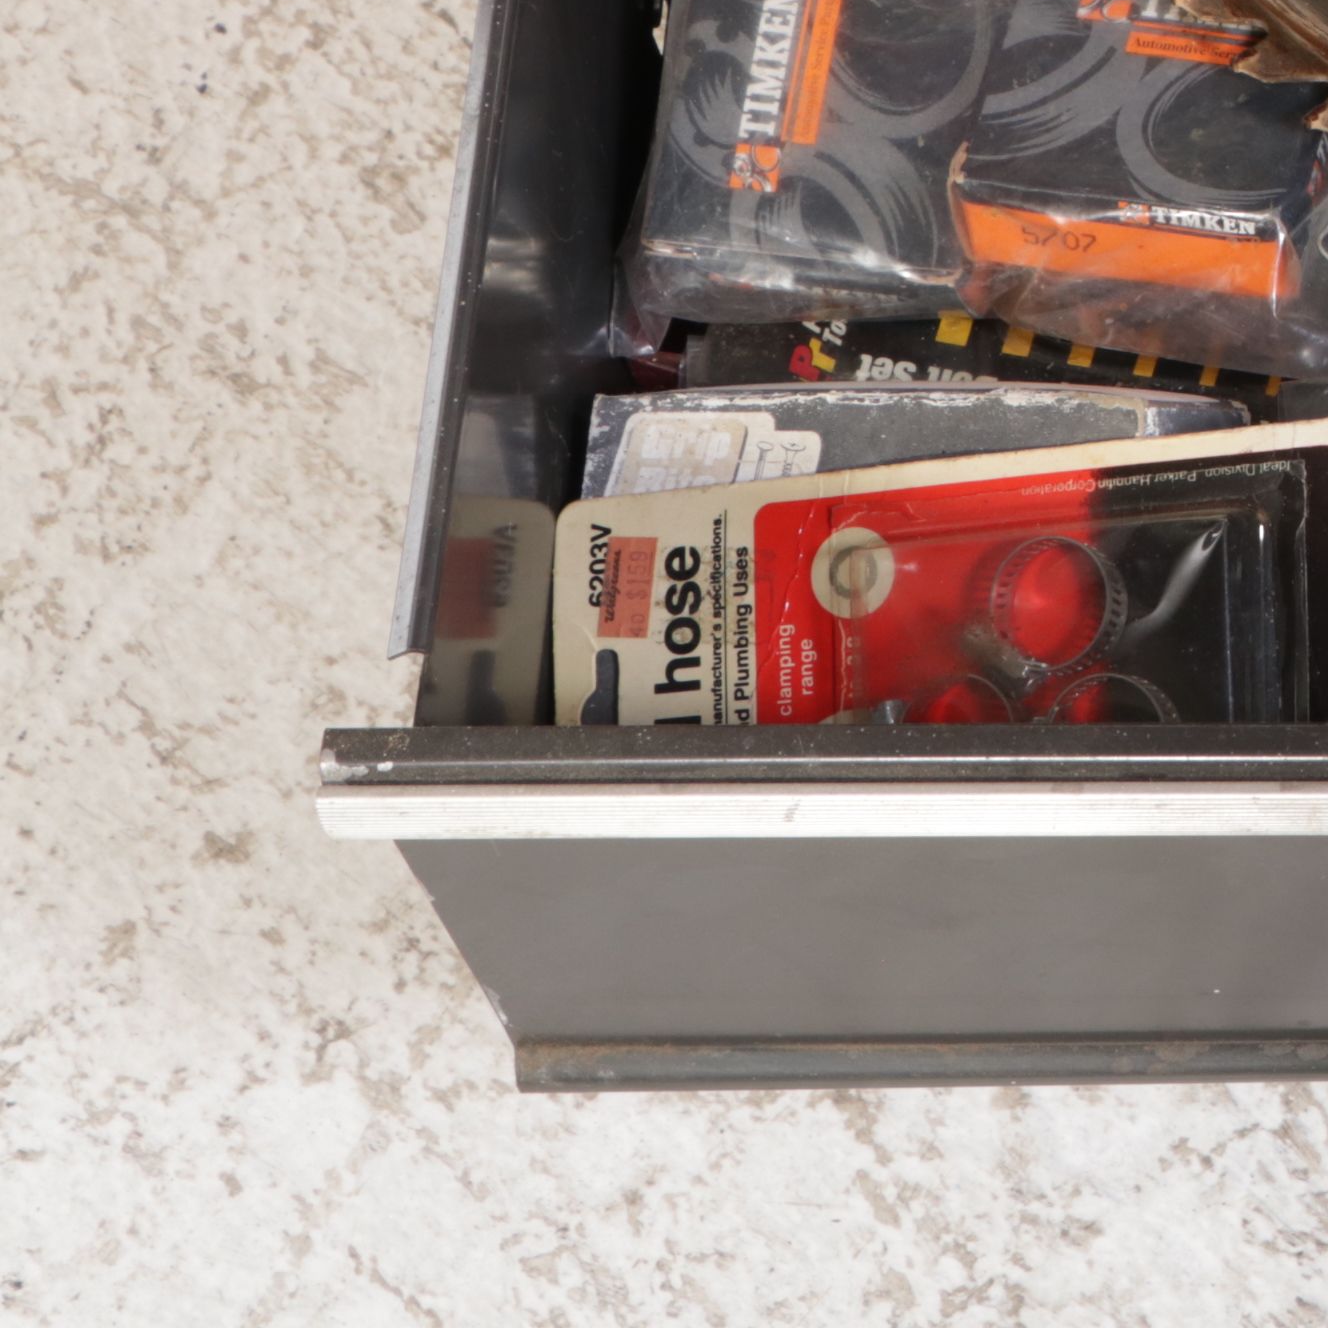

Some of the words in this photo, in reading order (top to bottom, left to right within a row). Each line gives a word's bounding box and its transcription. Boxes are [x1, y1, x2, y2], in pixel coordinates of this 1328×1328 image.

[1133, 36, 1207, 56] Automotive
[1151, 205, 1257, 235] TIMKEN
[855, 353, 917, 381] Set
[640, 423, 732, 466] Grip
[1258, 460, 1291, 472] Ideal
[1021, 481, 1096, 496] Corporation
[1154, 469, 1196, 483] Parker
[588, 523, 612, 607] 6203V
[712, 513, 726, 619] specifications.
[733, 546, 749, 598] Uses
[654, 545, 702, 694] hose
[734, 603, 753, 702] Plumbing
[778, 623, 796, 716] clamping
[801, 638, 817, 695] range
